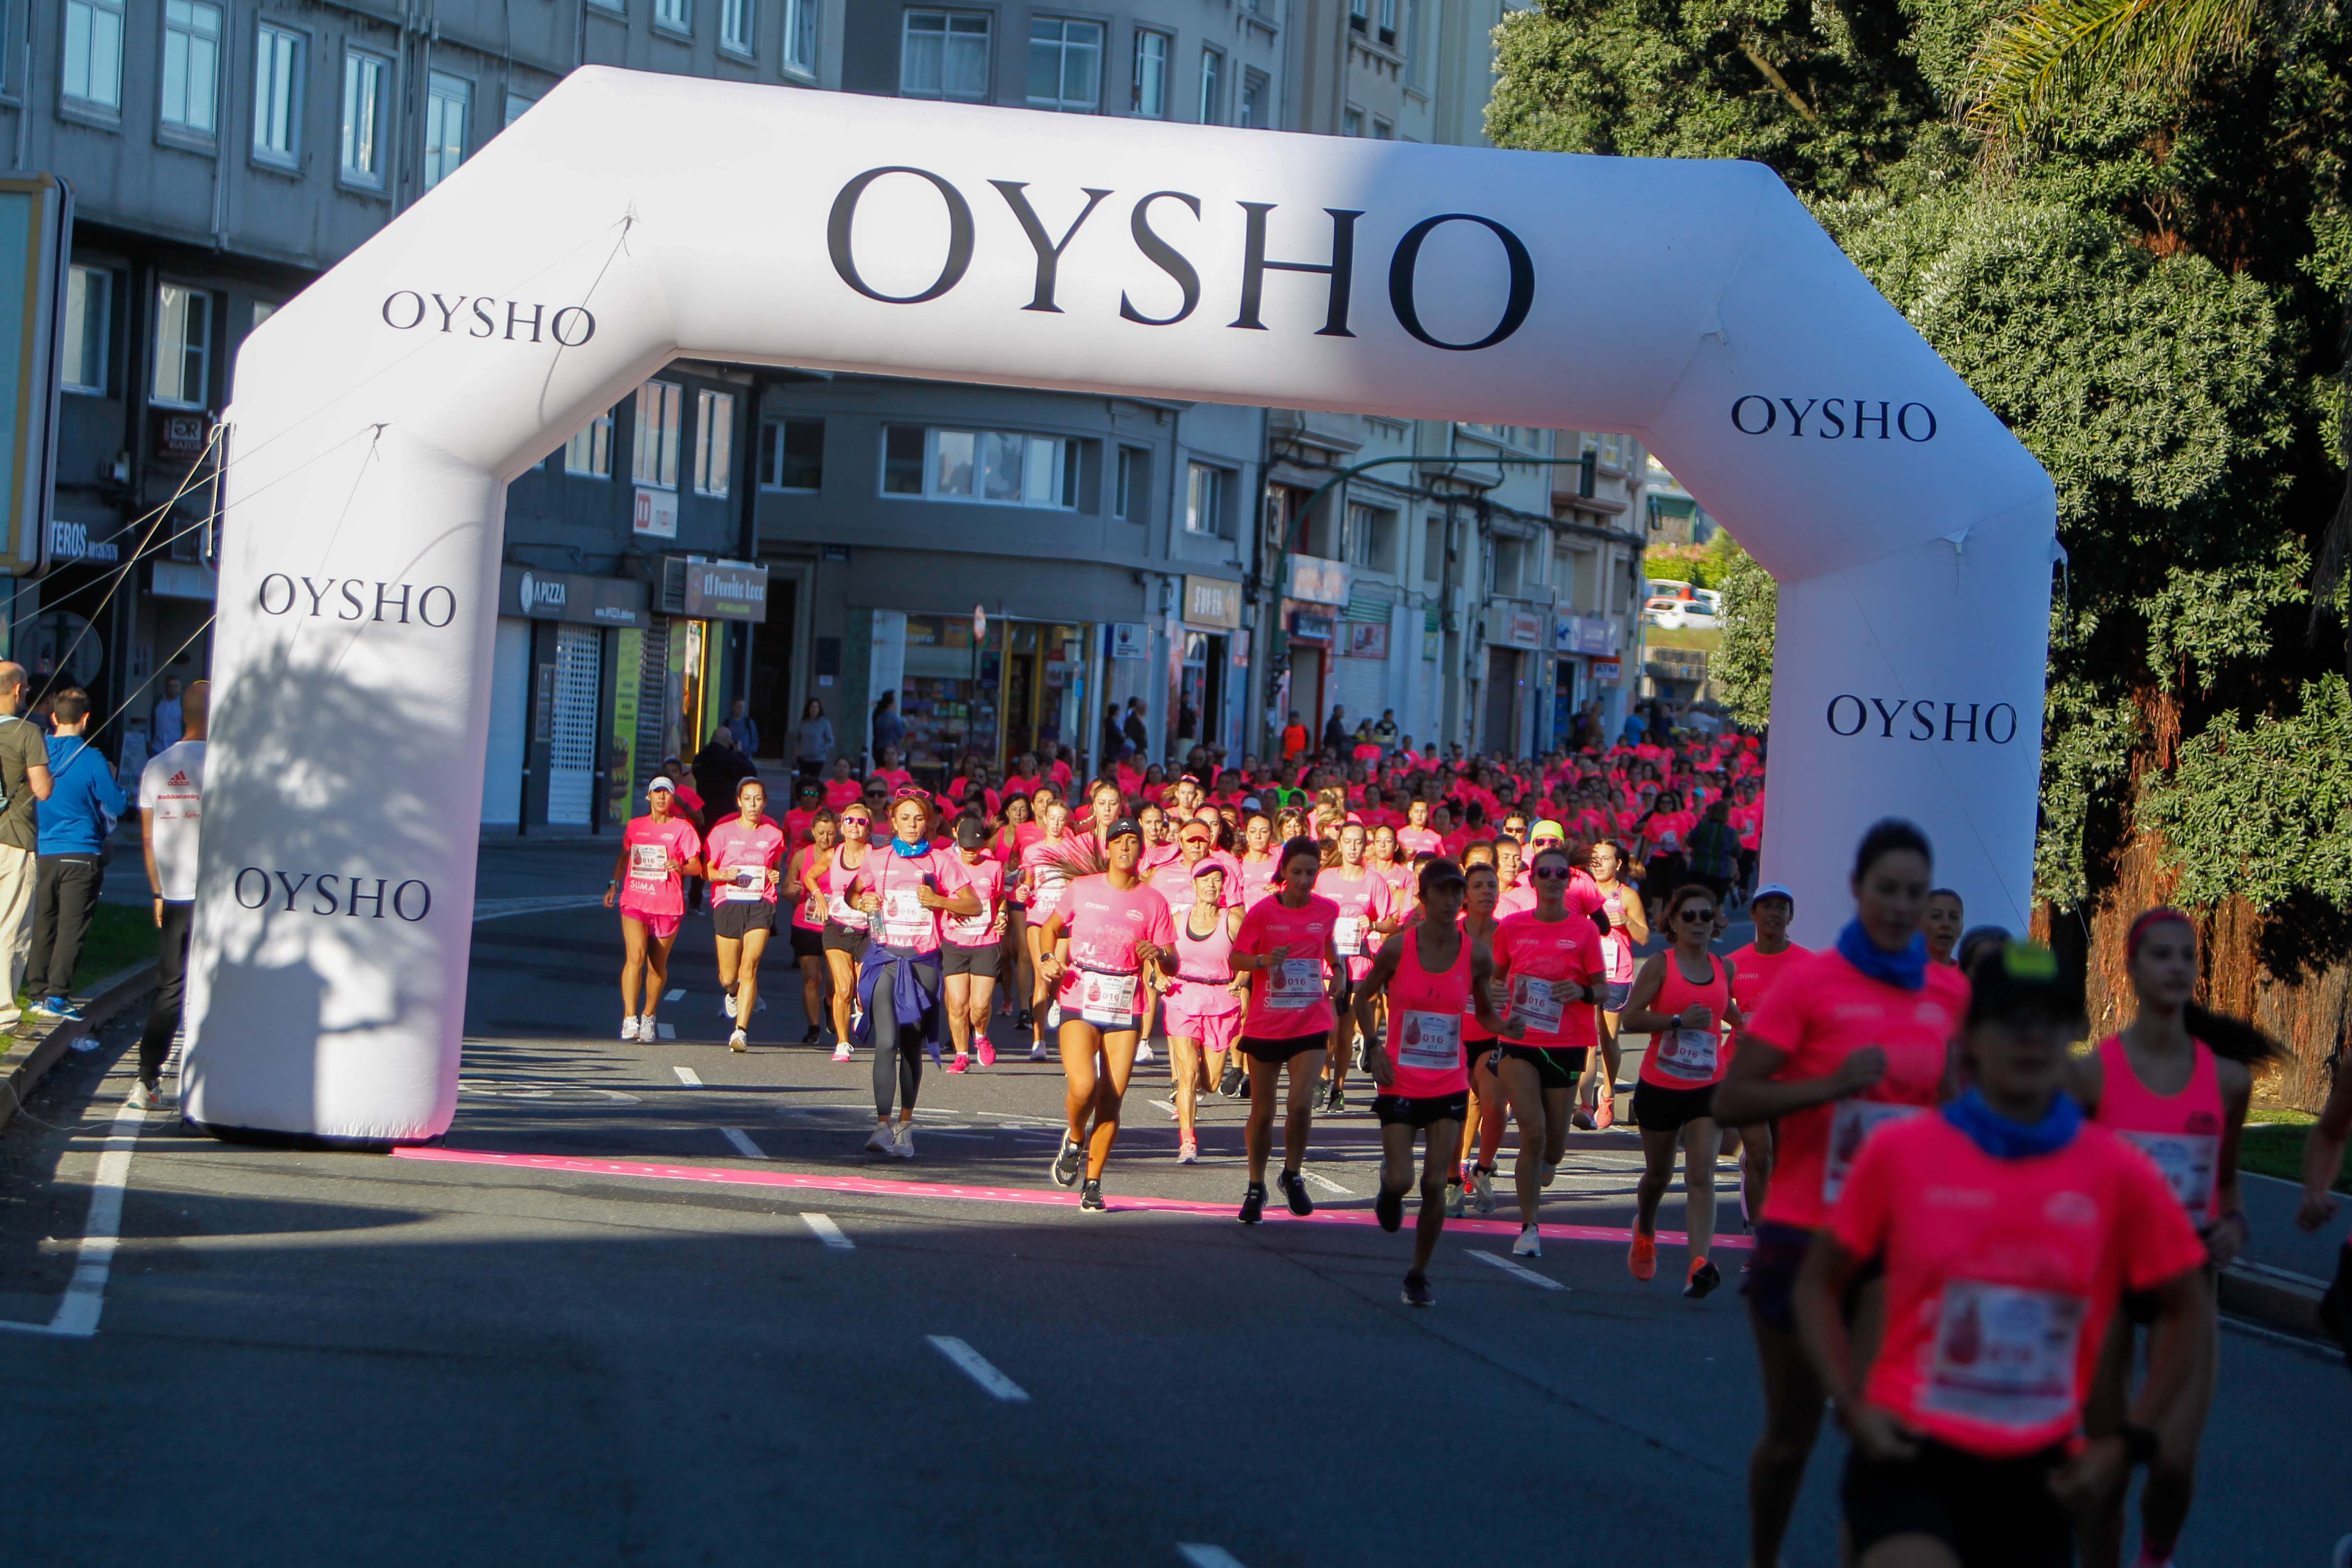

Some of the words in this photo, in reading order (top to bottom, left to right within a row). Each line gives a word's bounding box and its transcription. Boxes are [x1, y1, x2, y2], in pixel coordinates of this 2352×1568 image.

[826, 166, 1535, 352] OYSHO
[383, 291, 596, 347] OYSHO
[1732, 395, 1937, 442] OYSHO
[258, 574, 456, 627] OYSHO
[1827, 695, 2017, 744] OYSHO
[235, 868, 431, 921] OYSHO
[630, 880, 655, 892] SUMA
[1086, 902, 1110, 911] OYSHO
[1529, 996, 1545, 1006] 016
[1423, 1034, 1444, 1043] 016
[1679, 1047, 1698, 1058] 016
